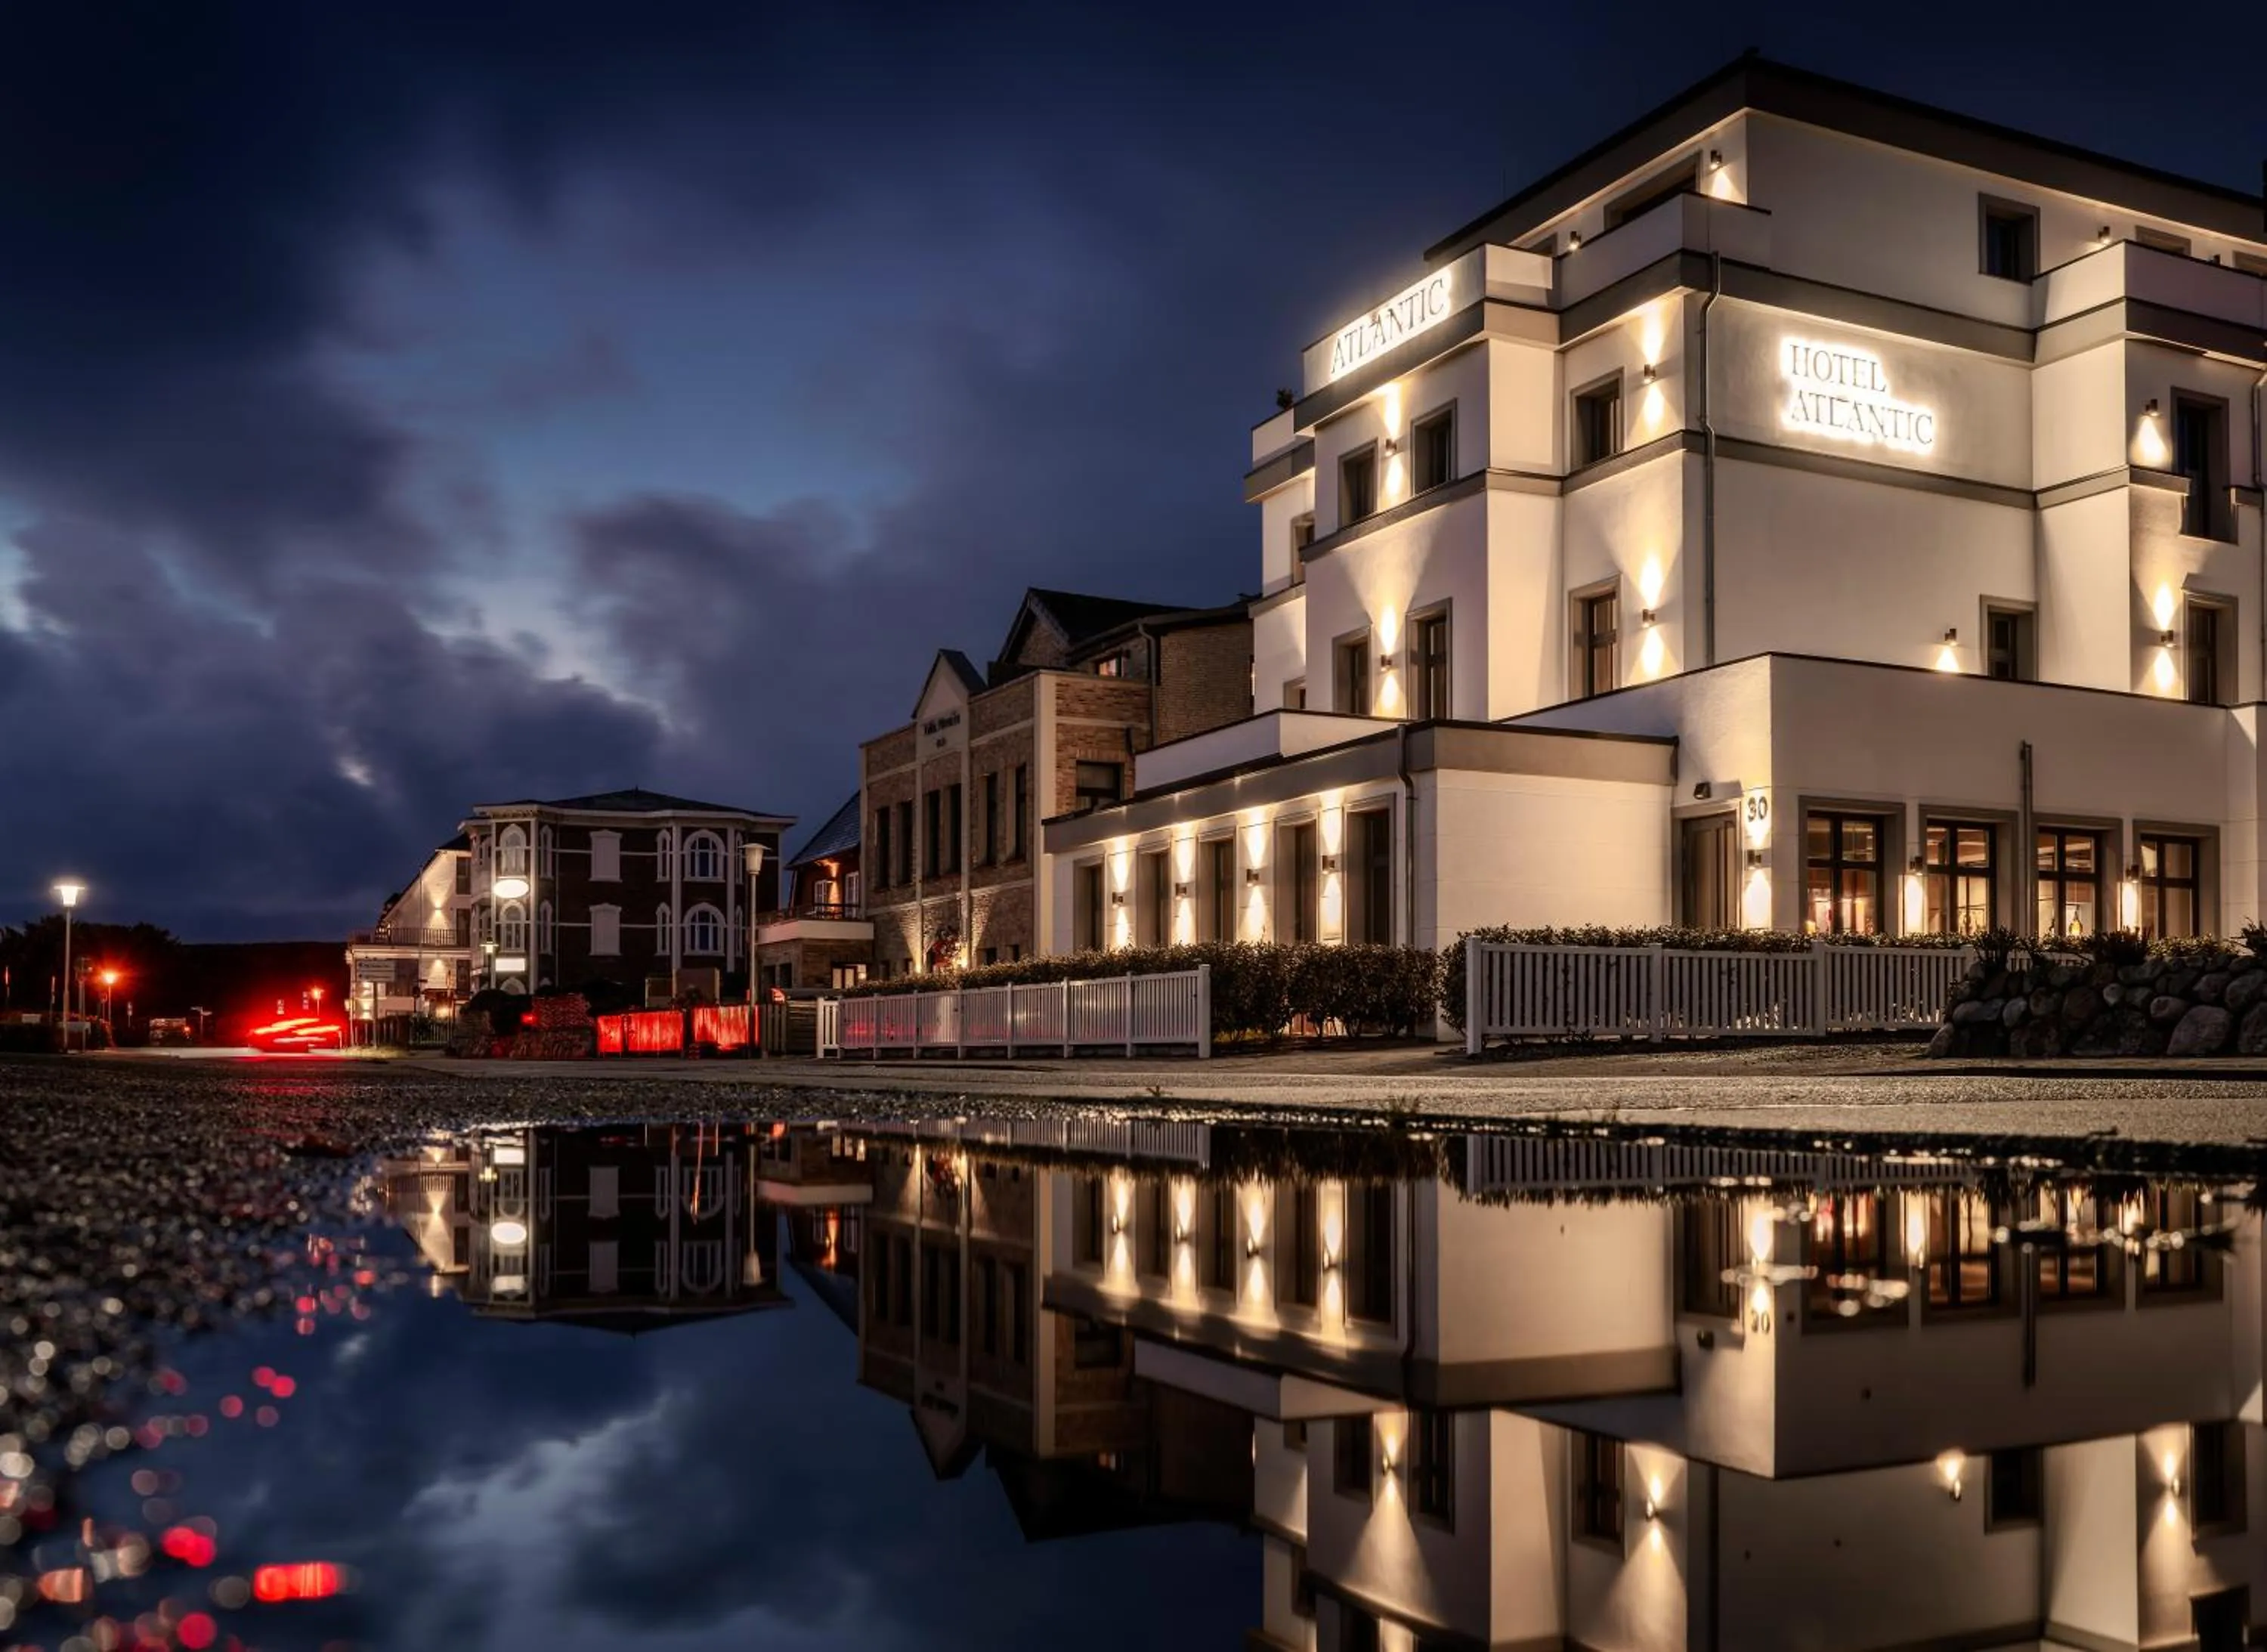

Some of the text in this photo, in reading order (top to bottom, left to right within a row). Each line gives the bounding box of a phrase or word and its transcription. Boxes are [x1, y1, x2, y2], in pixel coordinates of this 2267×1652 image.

[1331, 277, 1444, 374] ATLANTIC
[1789, 344, 1887, 393] HOTEL
[1790, 388, 1933, 445] ATLANTIC
[1747, 795, 1768, 823] 30
